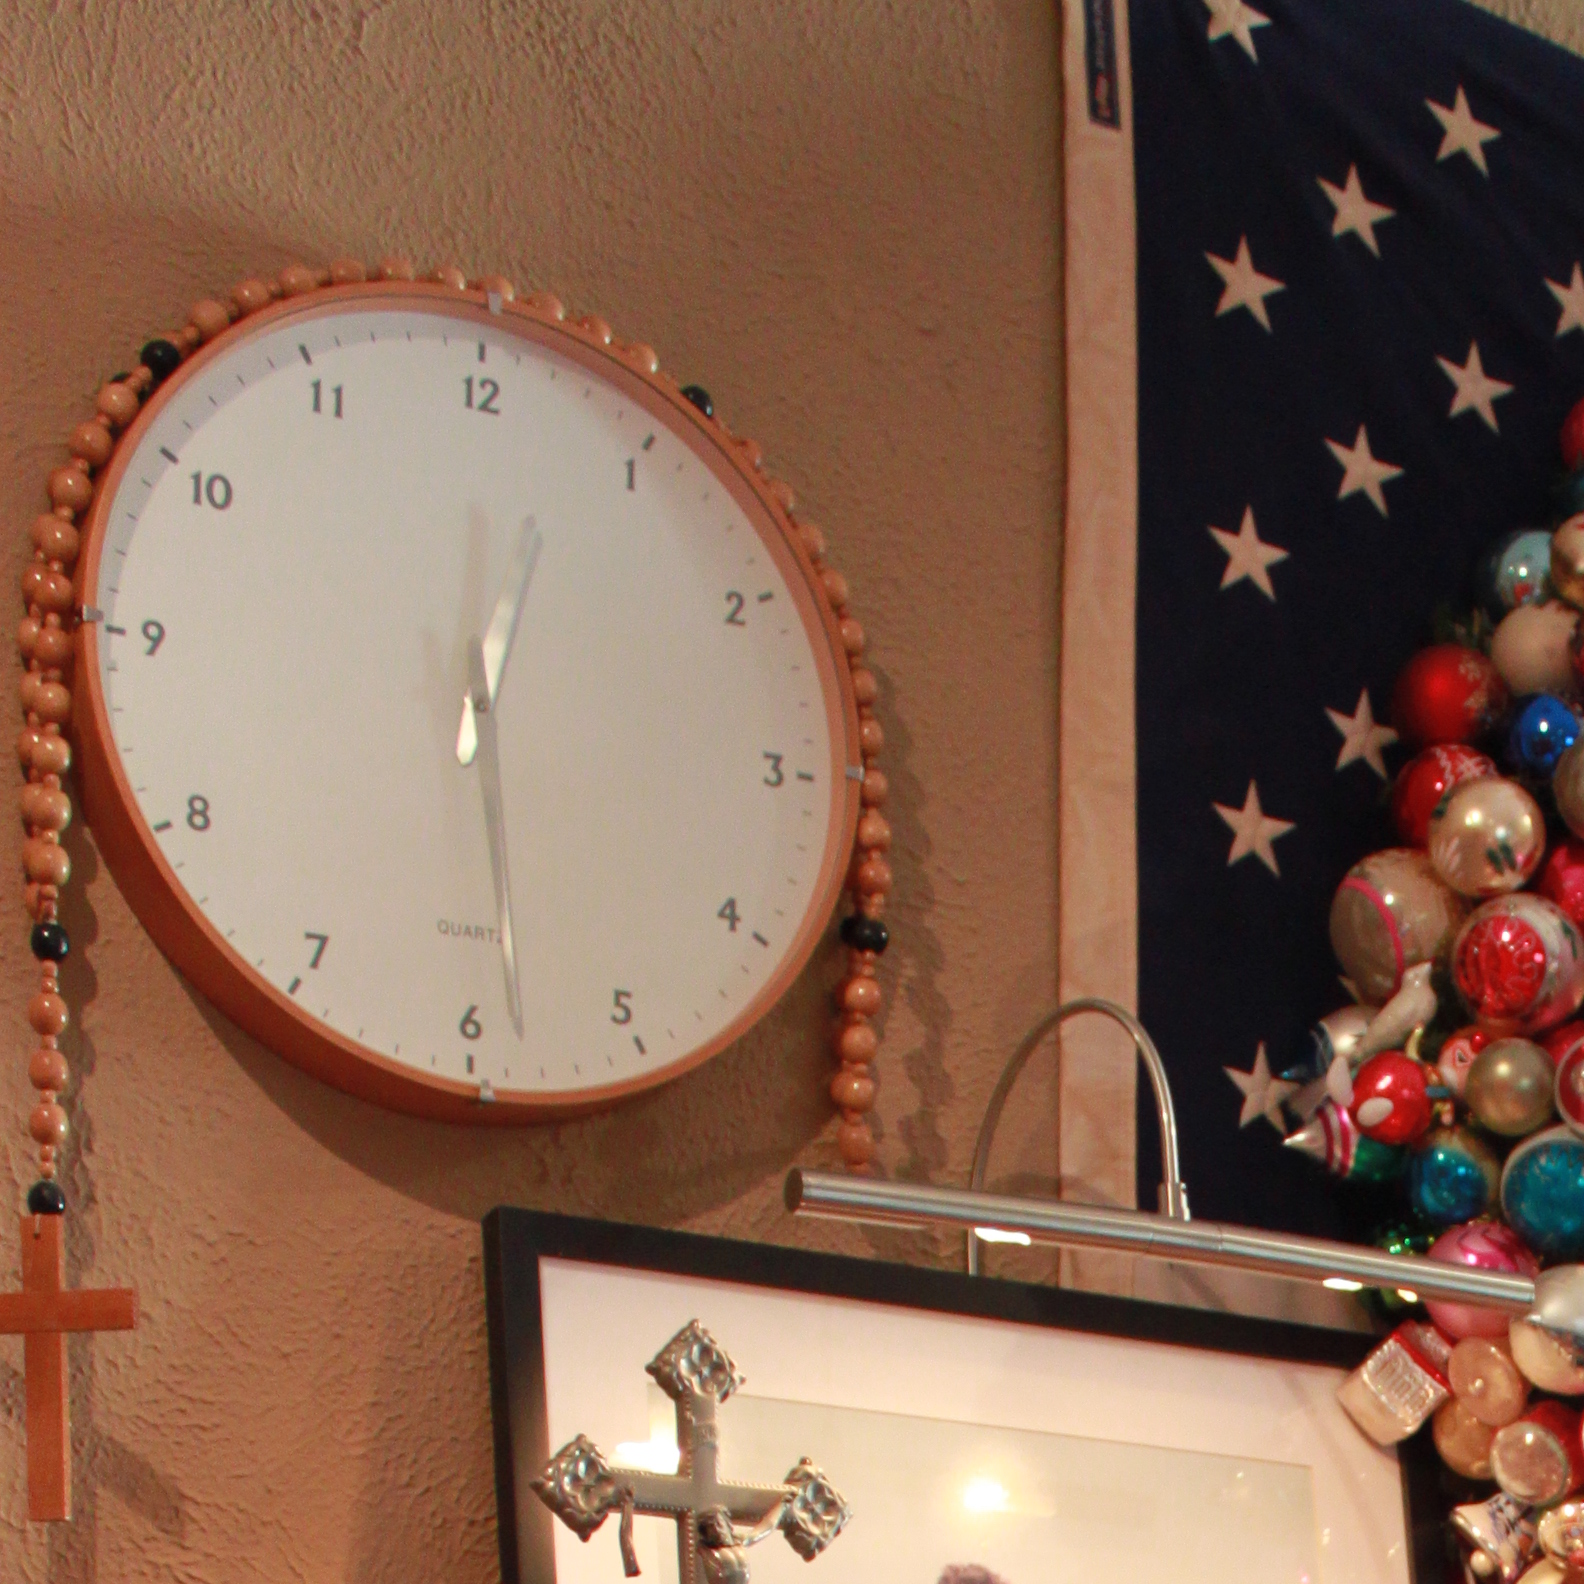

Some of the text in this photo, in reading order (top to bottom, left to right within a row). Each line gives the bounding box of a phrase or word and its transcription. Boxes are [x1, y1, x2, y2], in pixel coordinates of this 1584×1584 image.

[311, 384, 346, 419] 11
[462, 377, 502, 416] 12
[190, 472, 233, 510] 10
[625, 460, 637, 491] 1
[725, 592, 746, 626] 2
[142, 621, 165, 656] 9
[763, 754, 785, 787] 3
[186, 796, 212, 832] 8
[716, 898, 741, 931] 4
[303, 932, 330, 969] 7
[459, 1005, 483, 1040] 6
[611, 990, 634, 1025] 5
